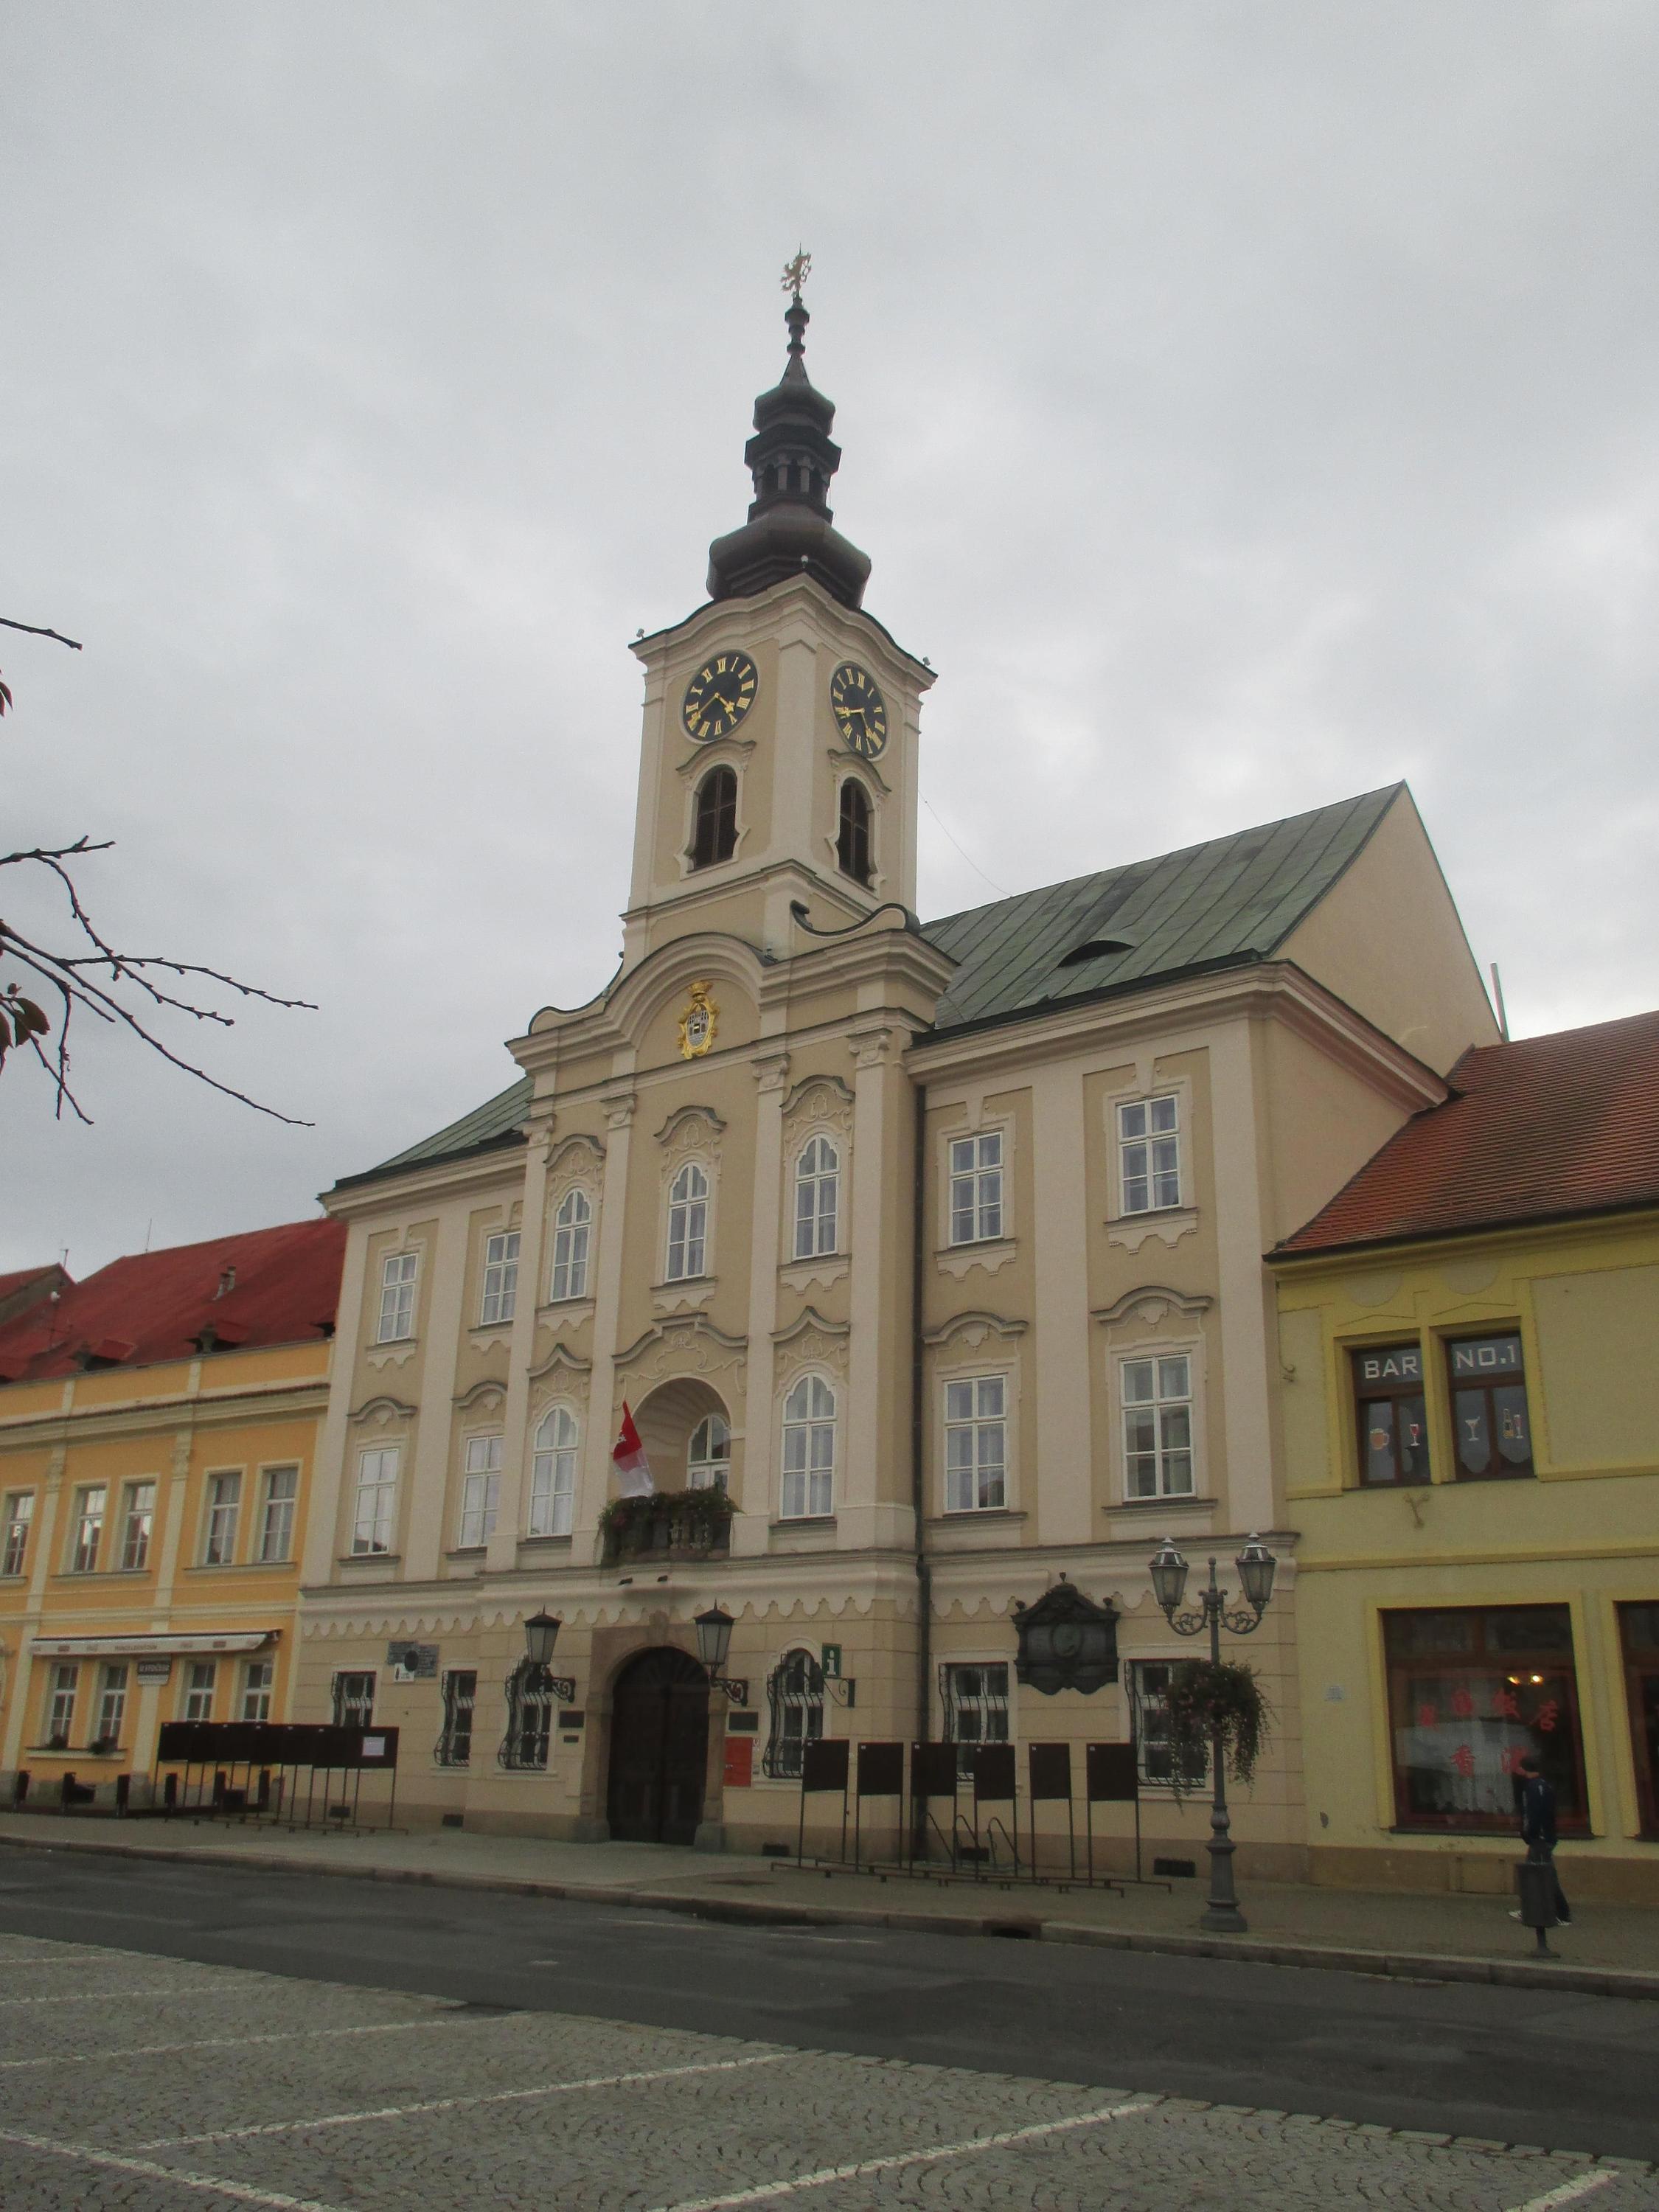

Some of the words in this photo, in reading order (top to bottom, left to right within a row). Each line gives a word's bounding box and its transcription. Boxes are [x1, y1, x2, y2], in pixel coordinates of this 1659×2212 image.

[717, 657, 726, 674] XII
[731, 657, 739, 672] I
[738, 664, 751, 679] II
[690, 686, 703, 695] X
[742, 678, 754, 692] III
[1364, 1356, 1418, 1379] BAR
[1455, 1345, 1516, 1369] NO.1
